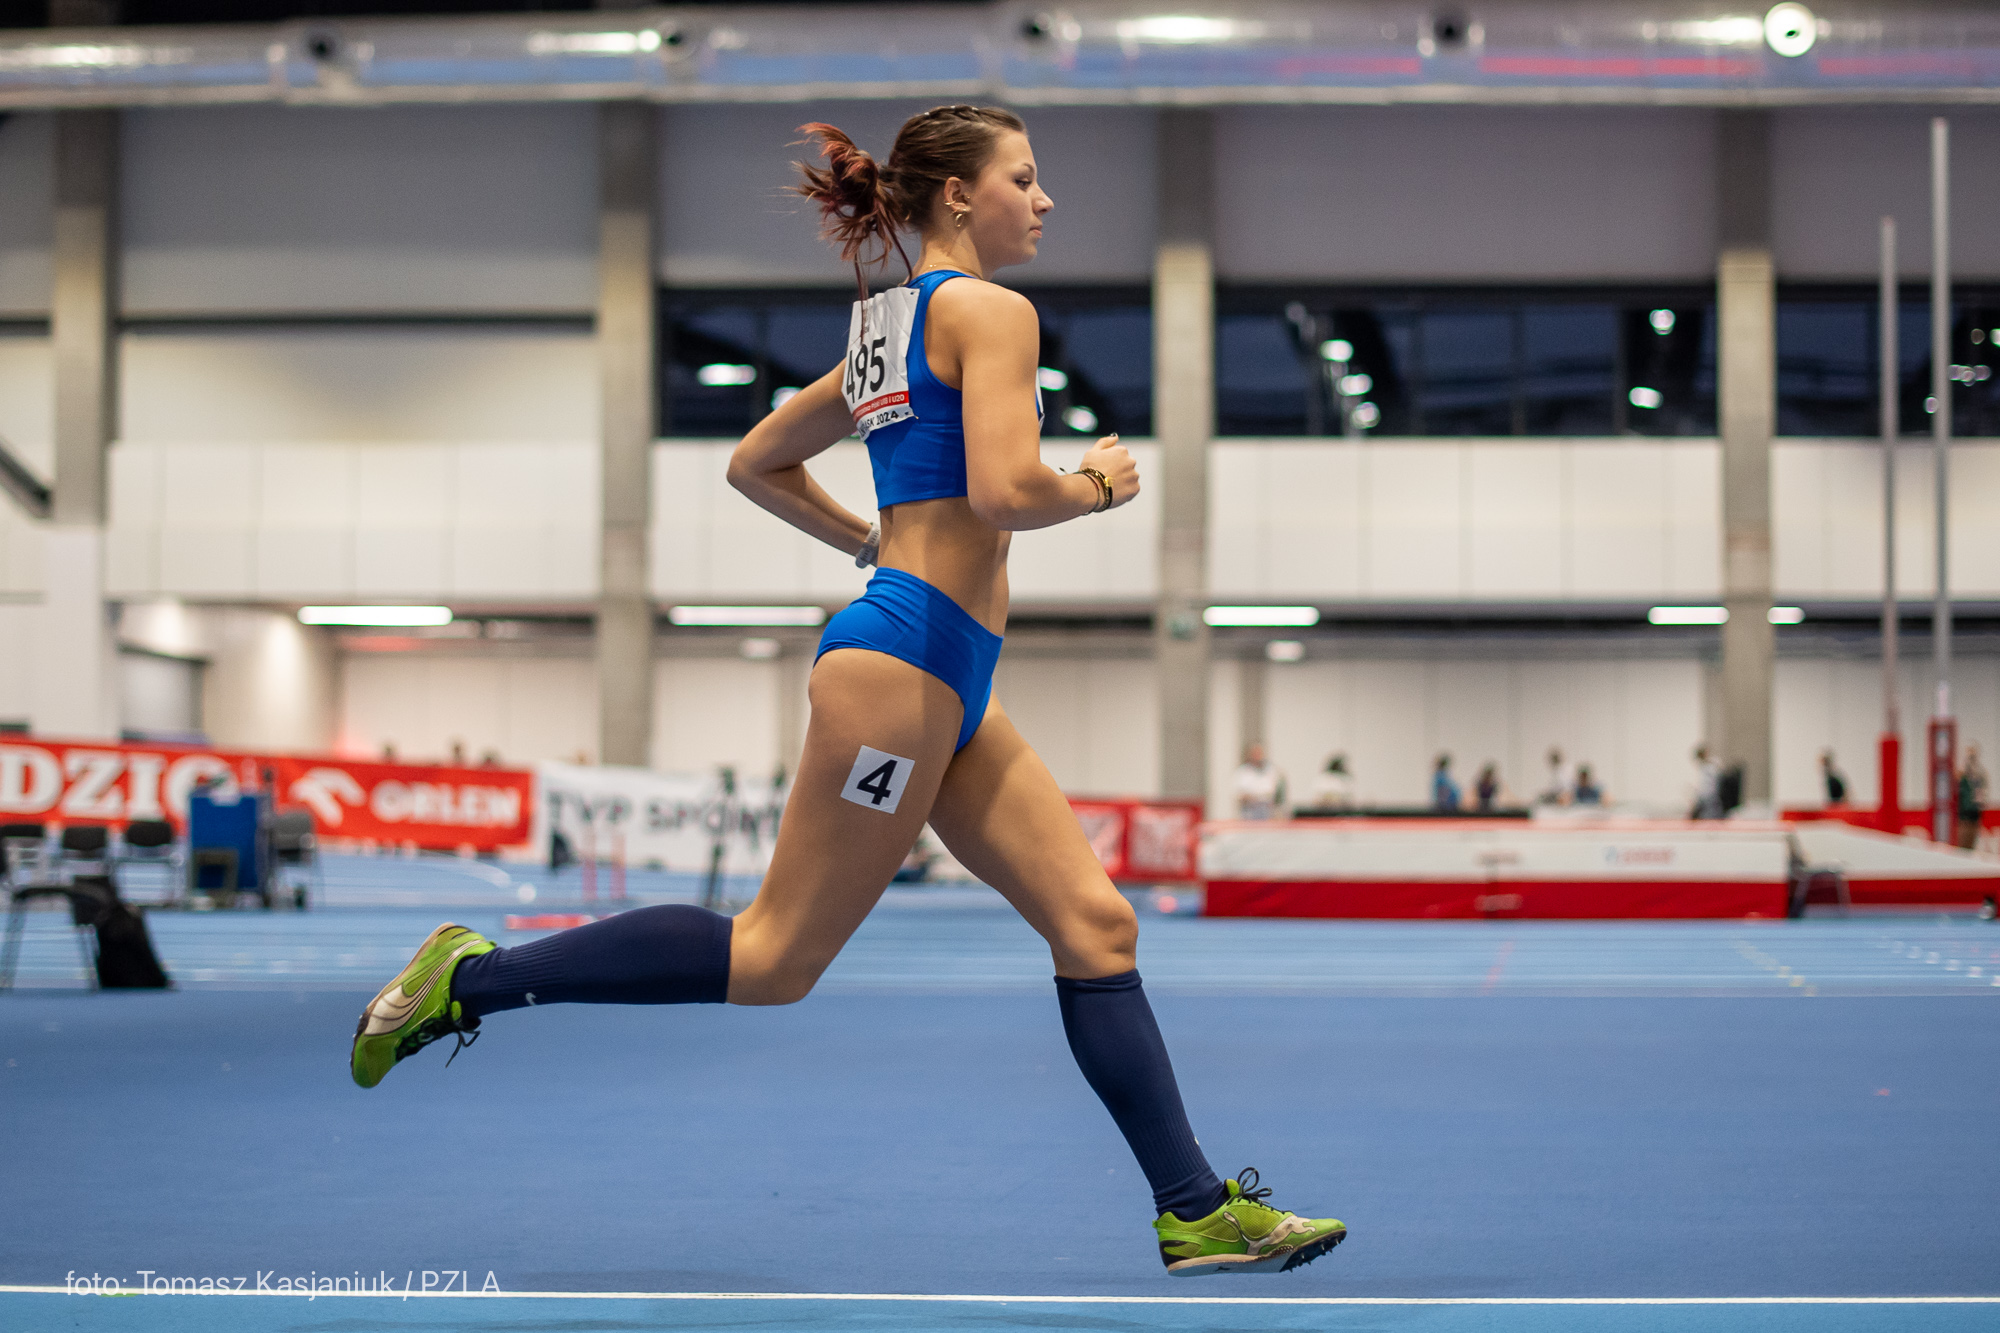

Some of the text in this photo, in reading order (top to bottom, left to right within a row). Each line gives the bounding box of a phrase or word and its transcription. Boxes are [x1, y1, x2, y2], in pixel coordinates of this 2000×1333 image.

[846, 336, 887, 404] 495
[876, 410, 900, 426] 2024
[369, 779, 522, 829] ORLEN
[856, 759, 898, 806] 4
